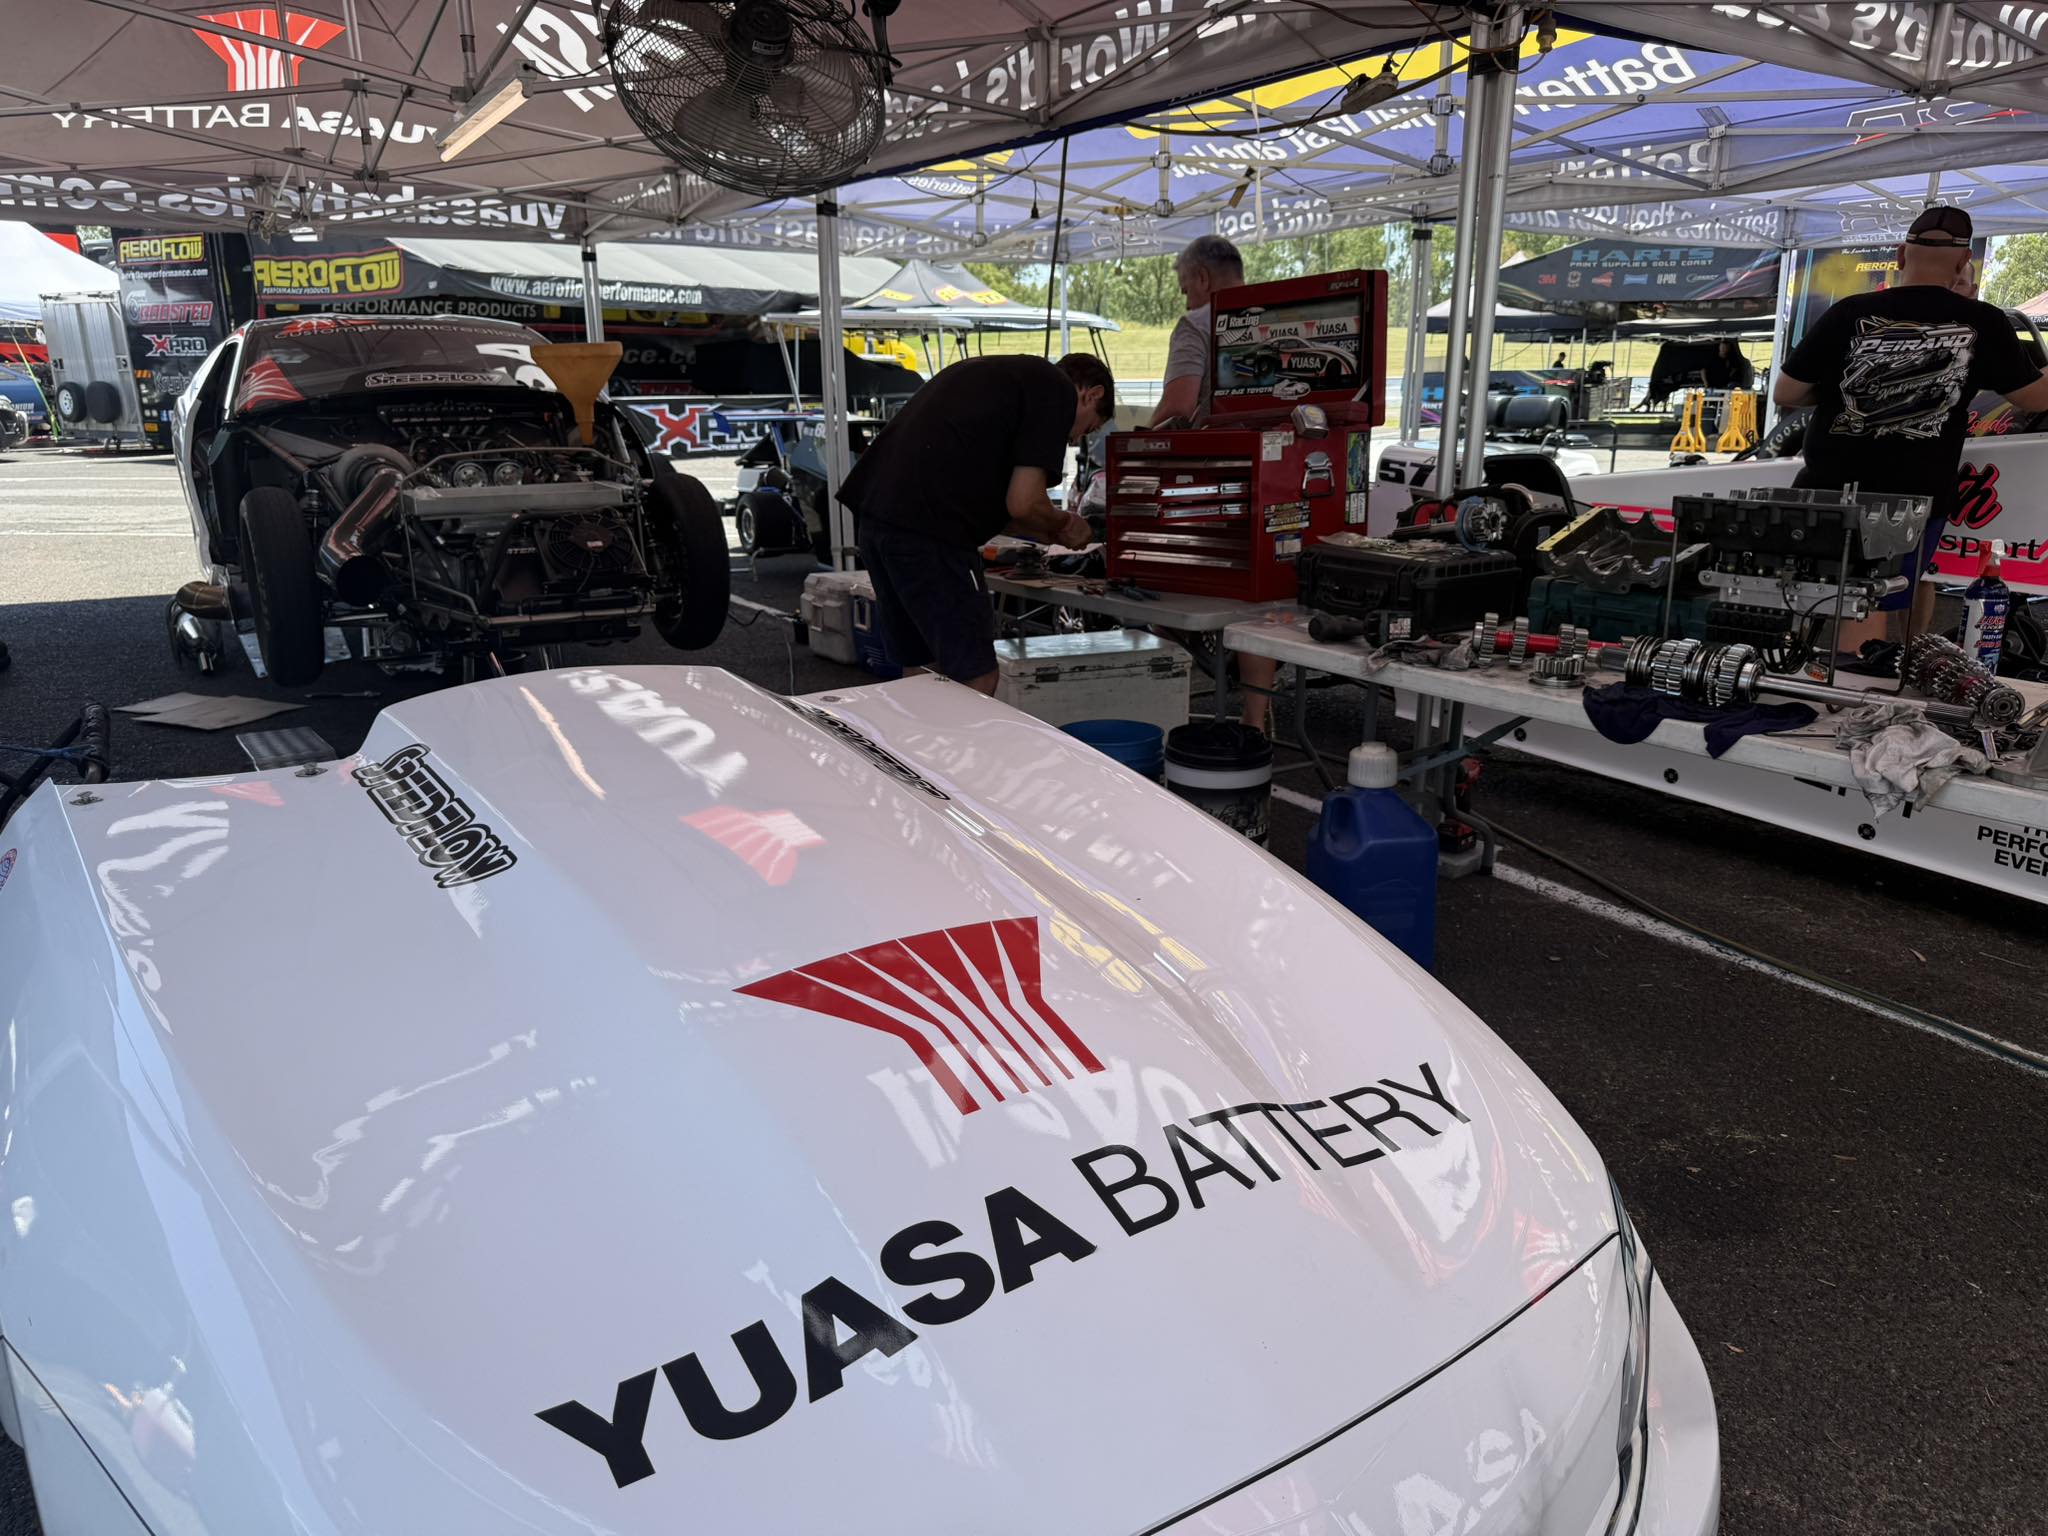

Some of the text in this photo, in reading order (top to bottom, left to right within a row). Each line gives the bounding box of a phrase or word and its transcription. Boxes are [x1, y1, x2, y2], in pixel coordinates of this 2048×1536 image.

[120, 236, 203, 262] AEROFLOW
[1571, 247, 1715, 262] HARTS
[253, 251, 401, 294] AEROFLOW
[1855, 260, 1899, 273] AEROFL
[1538, 274, 1557, 286] 3M
[320, 299, 538, 319] PERFORMANCE PRODUCTS
[1229, 313, 1260, 328] Racing
[1316, 322, 1348, 336] YUASA
[142, 334, 208, 357] XPRO
[1290, 356, 1322, 369] YUASA
[366, 371, 500, 388] SPEEDFLOW
[1378, 457, 1436, 488] 57
[1938, 535, 2041, 561] sprt
[351, 743, 518, 889] SPEEDFLOW
[534, 1186, 1098, 1490] YUASA
[1071, 1063, 1472, 1238] BATTERY
